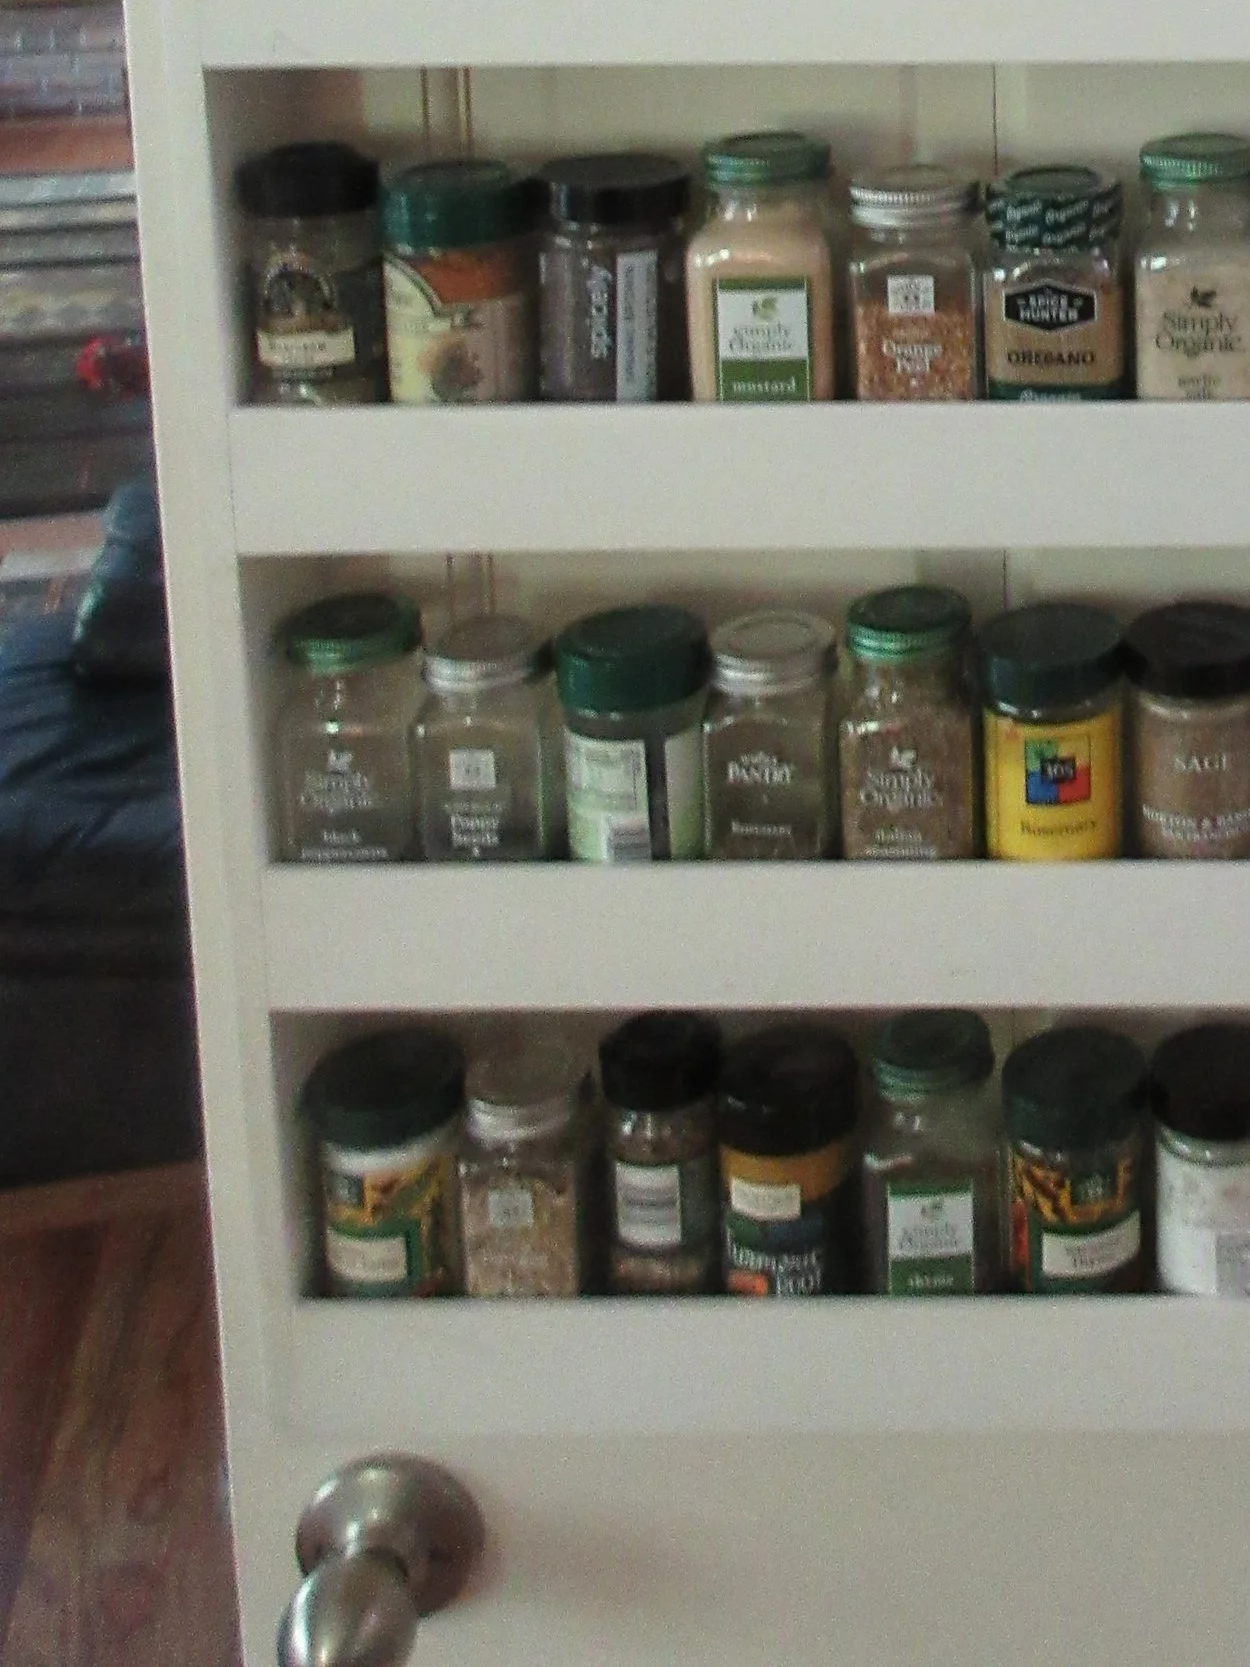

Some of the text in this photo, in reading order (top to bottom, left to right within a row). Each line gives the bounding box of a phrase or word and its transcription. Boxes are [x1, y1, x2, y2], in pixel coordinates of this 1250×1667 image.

[1028, 294, 1068, 308] SPICE
[1019, 307, 1079, 322] HUNTER
[1162, 310, 1238, 341] Simply
[1007, 350, 1096, 367] OREGANO
[732, 376, 796, 394] mustard
